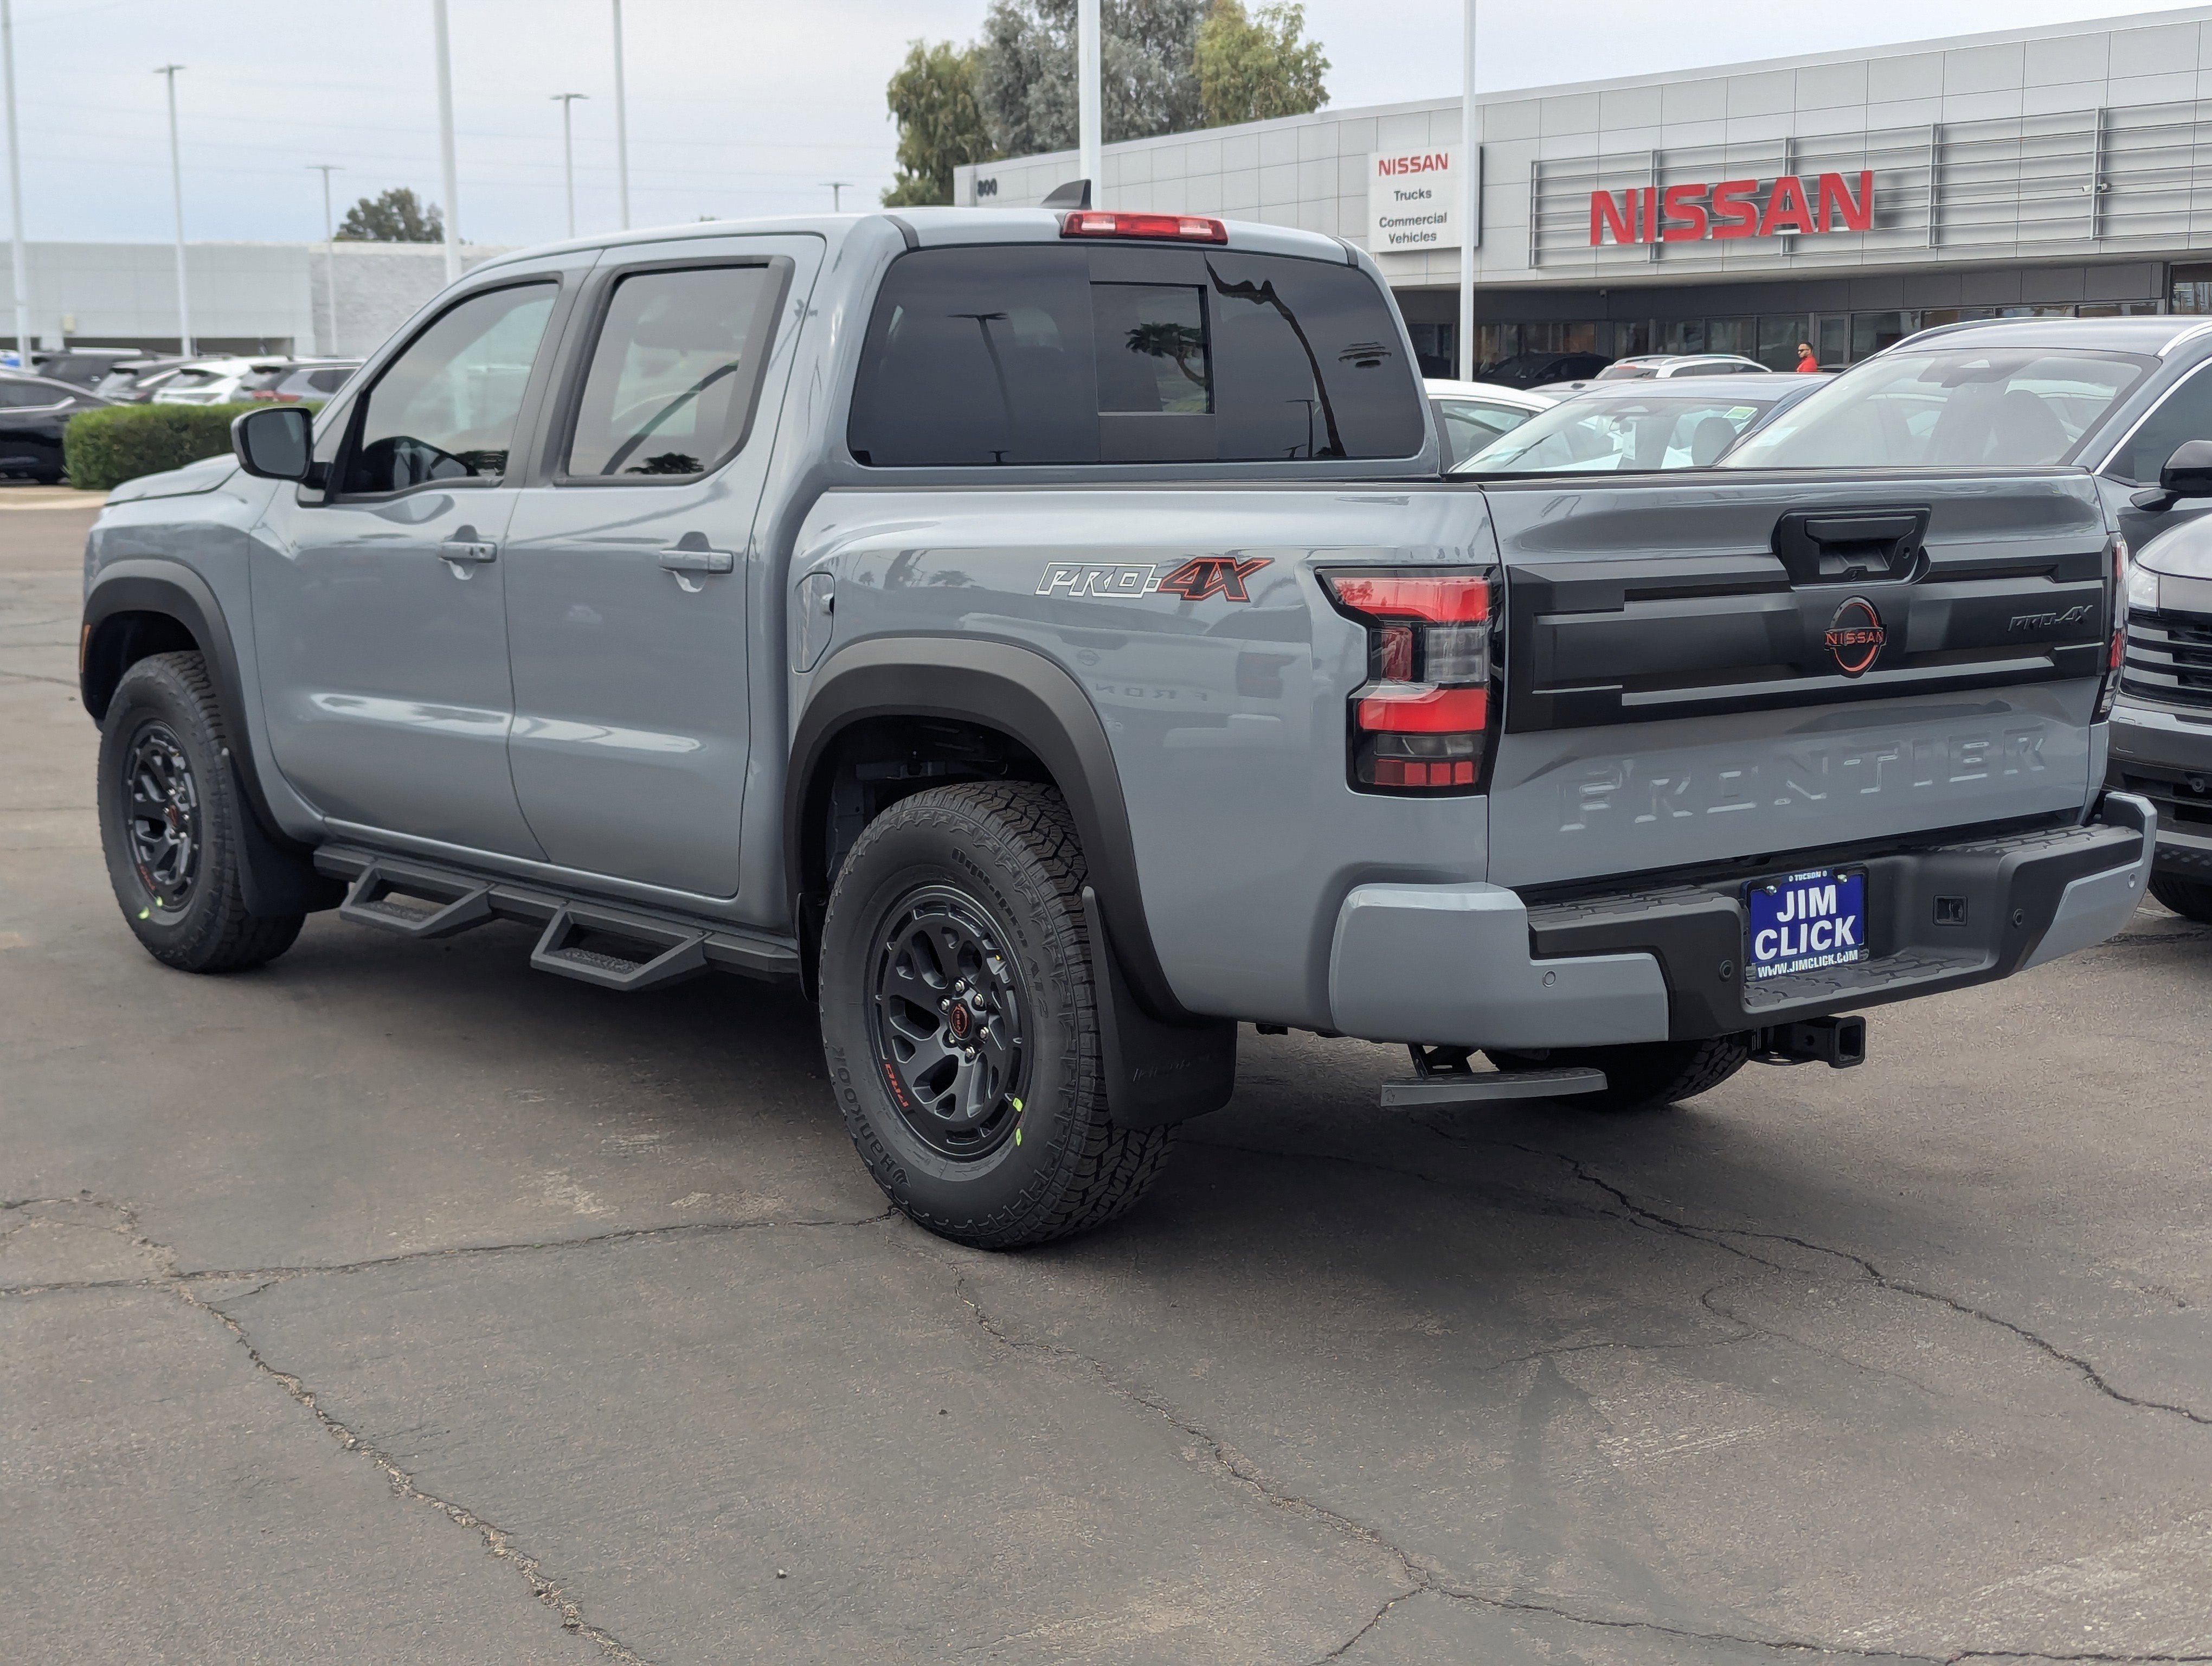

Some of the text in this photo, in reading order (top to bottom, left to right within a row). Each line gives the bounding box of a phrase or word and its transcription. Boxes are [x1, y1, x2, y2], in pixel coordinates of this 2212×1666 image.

[1378, 152, 1448, 177] NISSAN
[1394, 187, 1432, 201] Trucks
[1379, 212, 1447, 228] Commercial
[1590, 169, 1873, 246] NISSAN
[1388, 231, 1437, 244] Vehicles
[1825, 631, 1883, 645] NISSAN
[1557, 725, 2047, 831] FRONTIER
[1777, 885, 1836, 922] JIM
[1755, 915, 1856, 960] CLICK
[1758, 950, 1858, 978] WWW.JIMCLICK.COM
